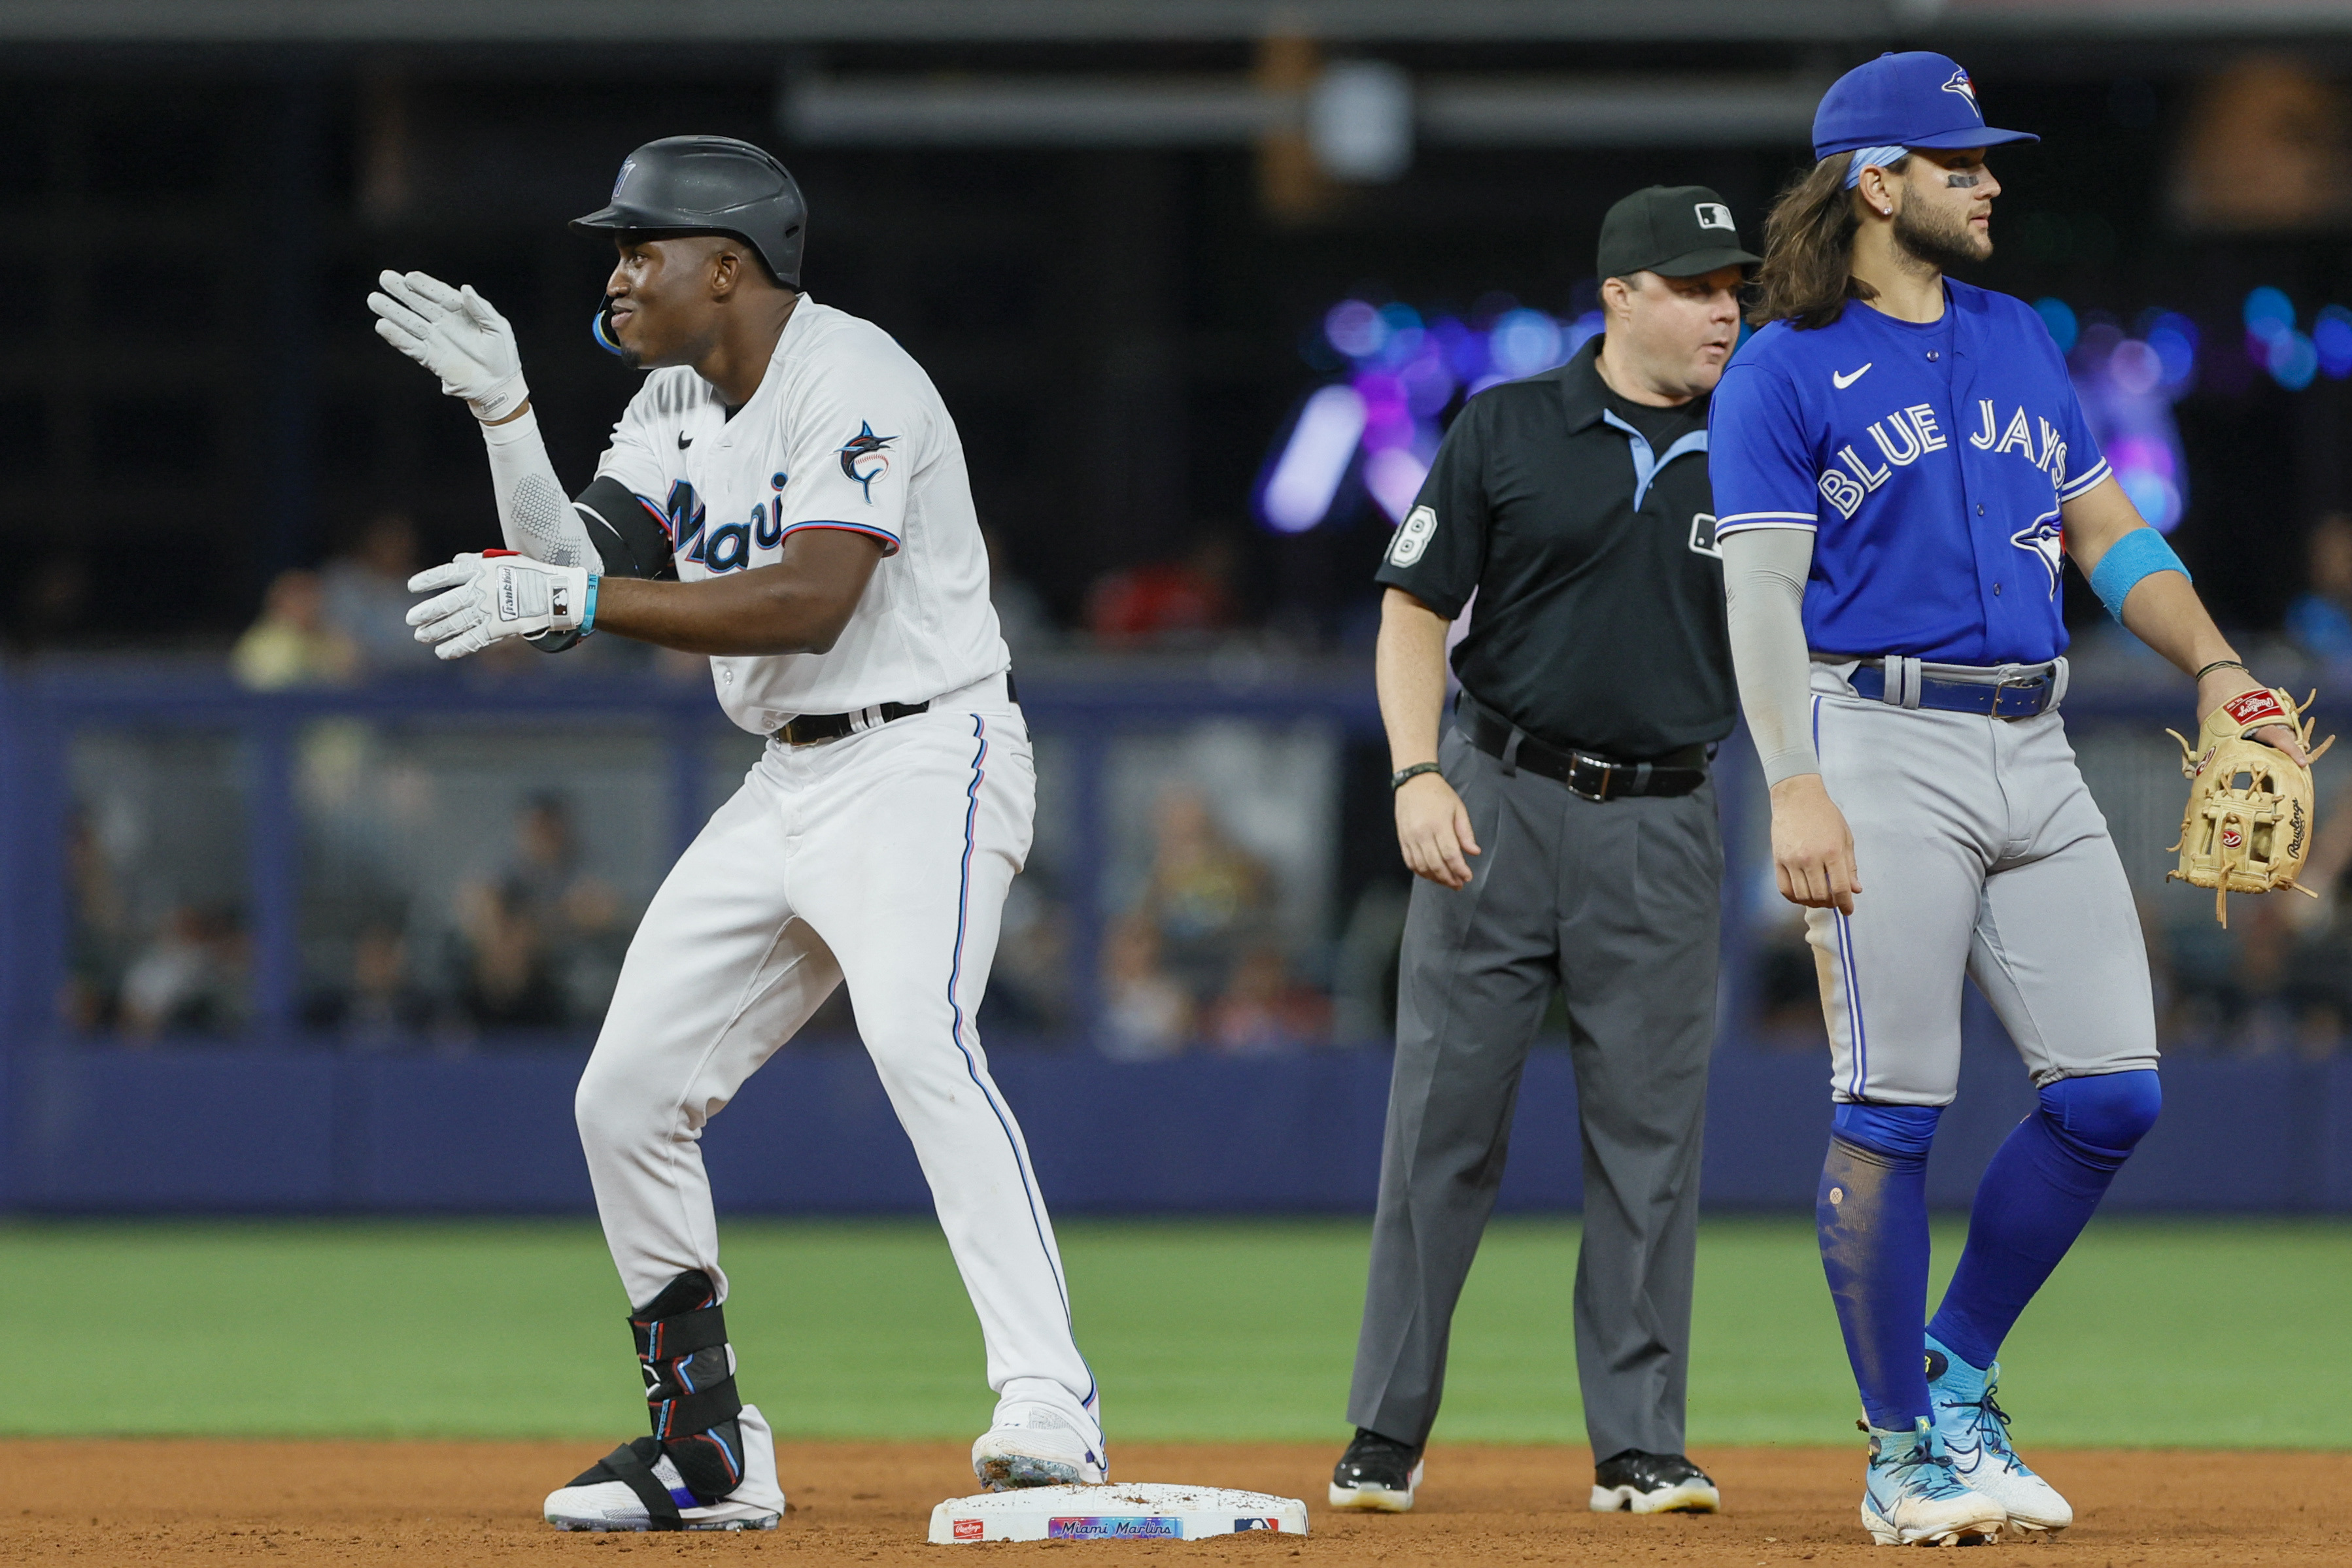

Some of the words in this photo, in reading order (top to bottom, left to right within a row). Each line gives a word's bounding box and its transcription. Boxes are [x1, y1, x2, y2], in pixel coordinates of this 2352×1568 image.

[1817, 403, 1948, 520] BLUE
[1969, 398, 2067, 490] JAYS
[502, 568, 517, 616] Franklin
[2237, 697, 2274, 717] Rawlings
[2287, 797, 2305, 860] Rawlings
[956, 1524, 981, 1535] Rawlings
[1062, 1521, 1109, 1535] Miami
[1115, 1521, 1172, 1535] Marlins
